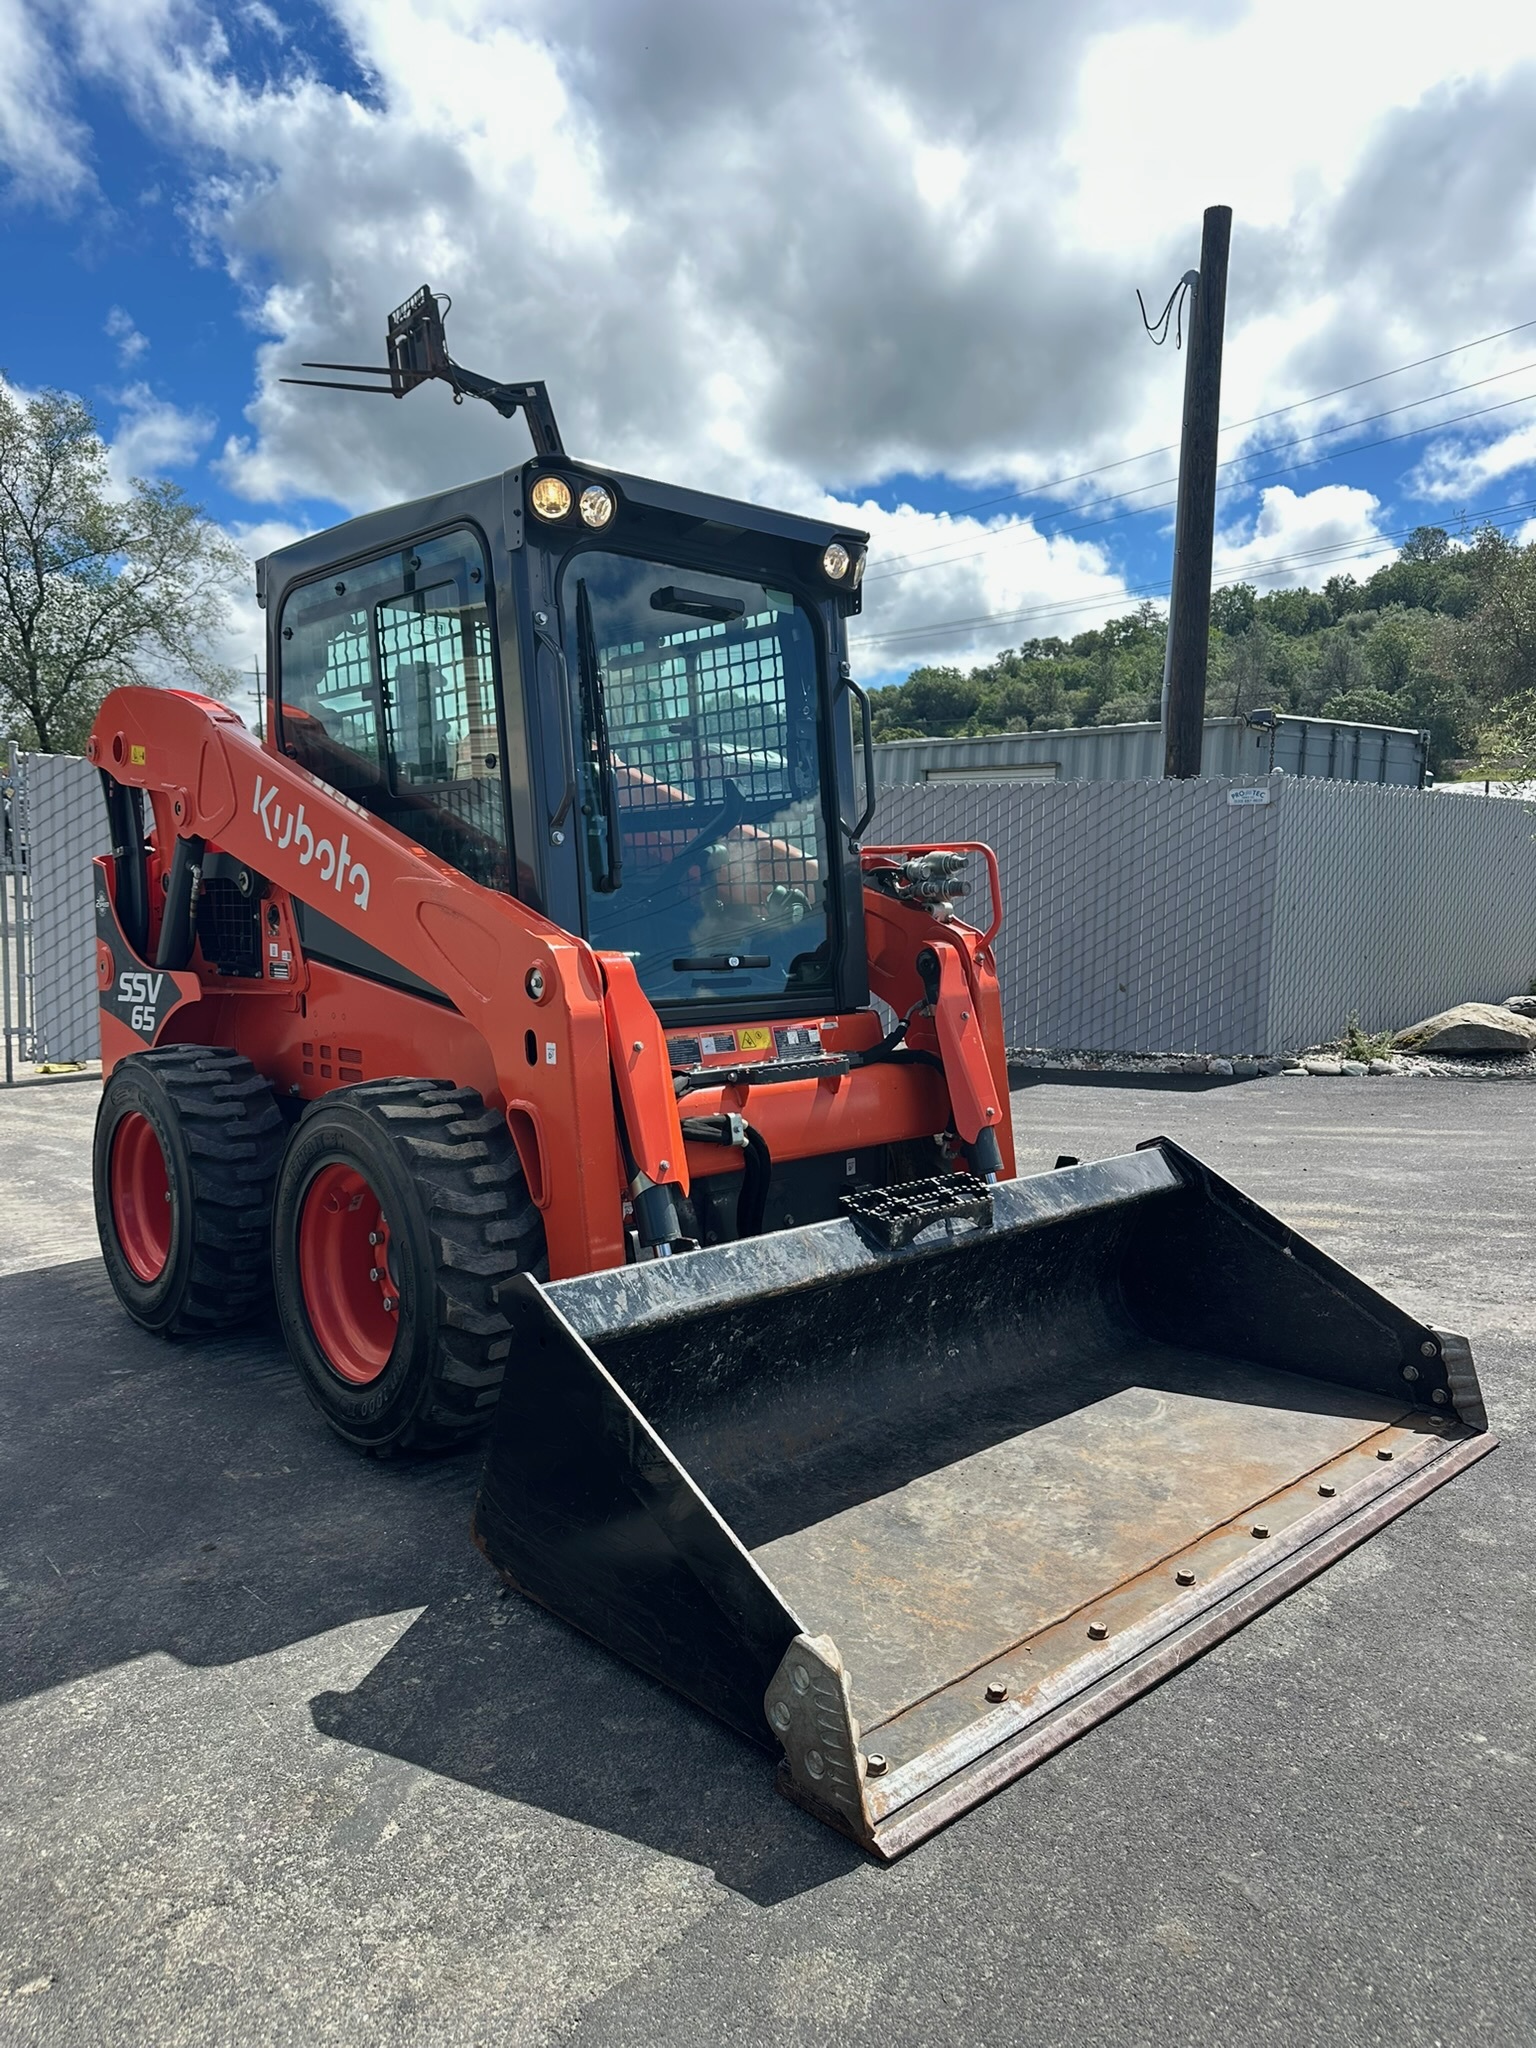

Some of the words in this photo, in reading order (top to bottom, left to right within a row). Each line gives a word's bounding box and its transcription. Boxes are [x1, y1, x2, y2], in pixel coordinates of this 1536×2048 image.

[1252, 789, 1266, 799] TEC
[252, 775, 371, 911] Kubota
[117, 972, 164, 1004] SSV
[131, 1005, 156, 1031] 65
